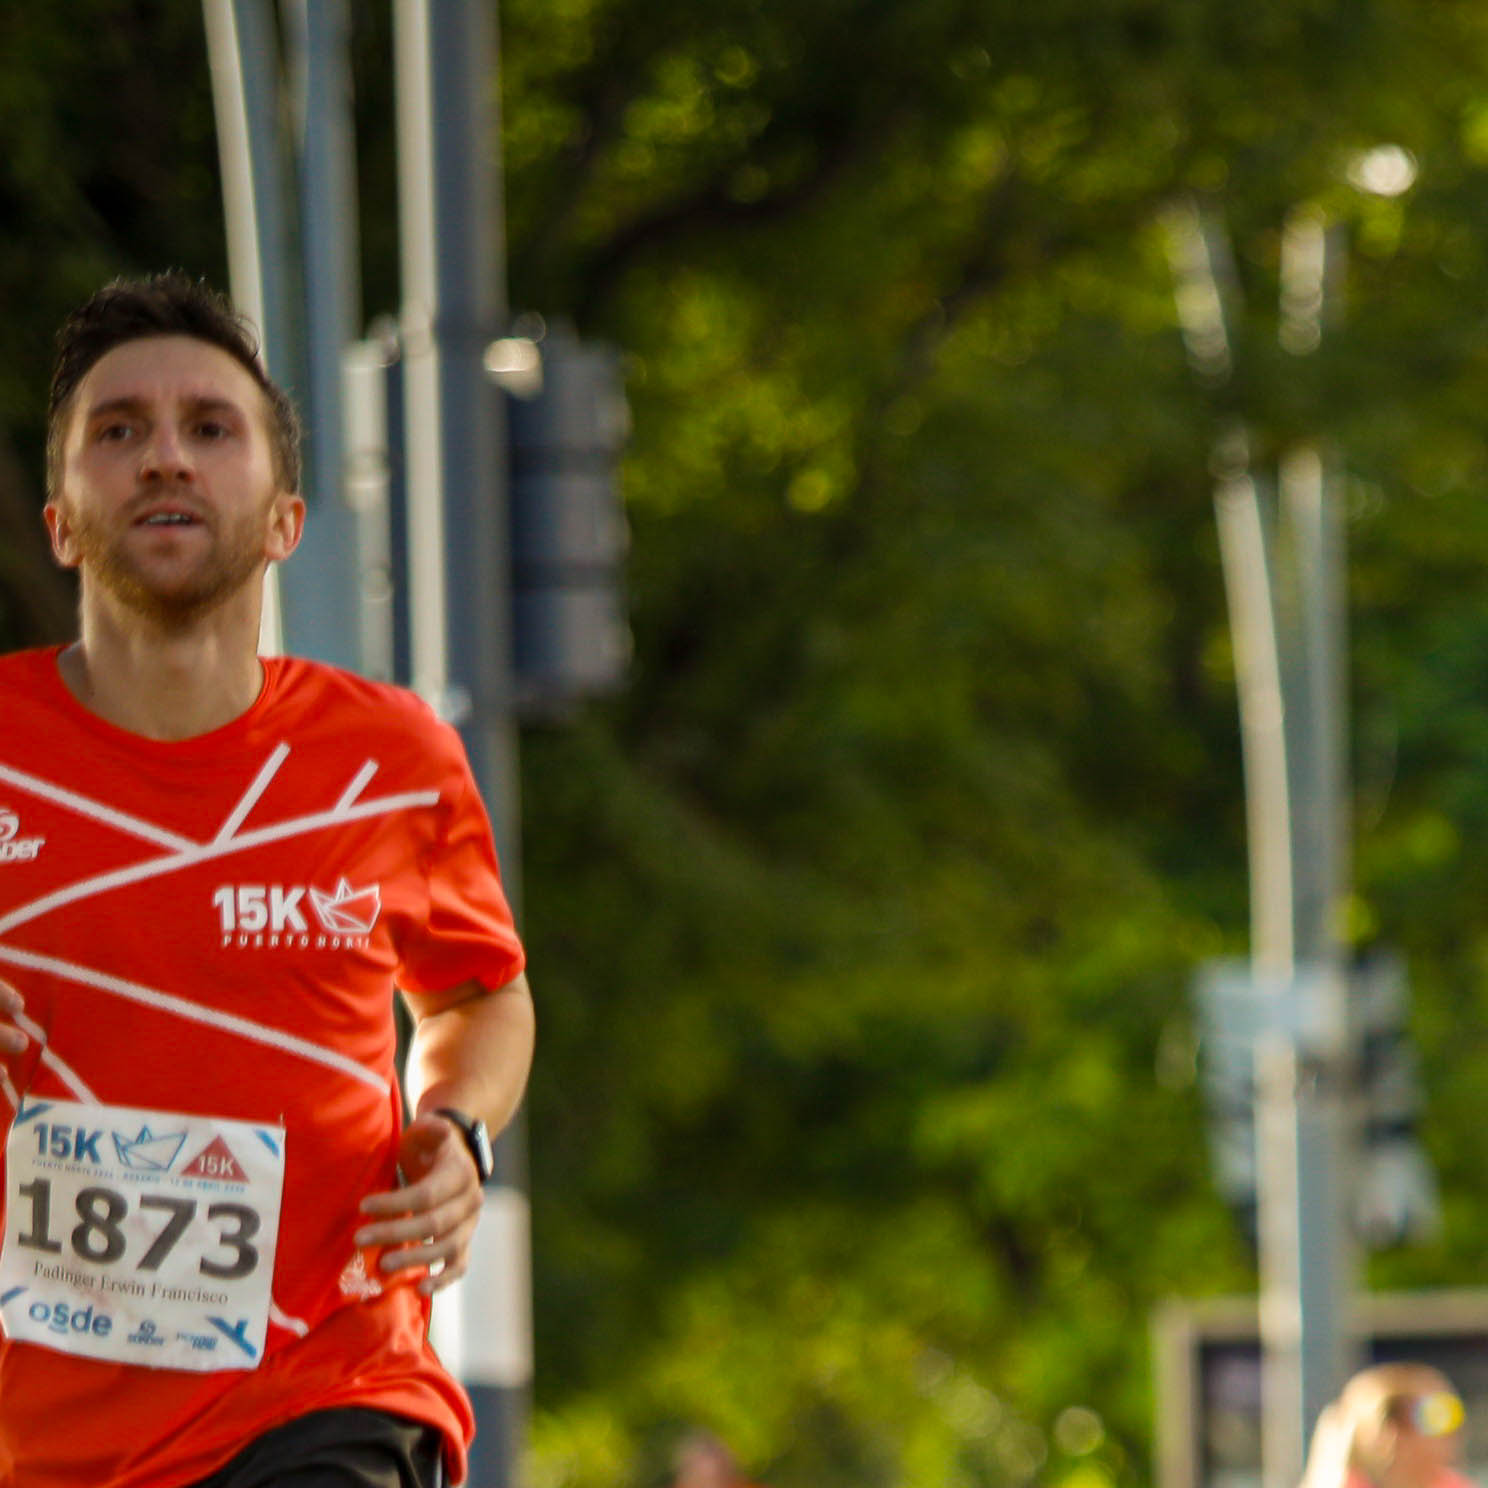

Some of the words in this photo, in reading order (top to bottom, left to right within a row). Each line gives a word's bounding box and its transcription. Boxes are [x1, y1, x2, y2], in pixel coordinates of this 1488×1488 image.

[212, 885, 308, 932] 15K
[224, 935, 308, 947] PUERTO
[33, 1121, 103, 1164] 15K
[199, 1155, 235, 1176] 15K
[18, 1177, 261, 1280] 1873
[34, 1260, 97, 1287] Padinger
[101, 1273, 145, 1297] Erwin
[151, 1282, 229, 1305] Francisco
[28, 1301, 113, 1337] osde
